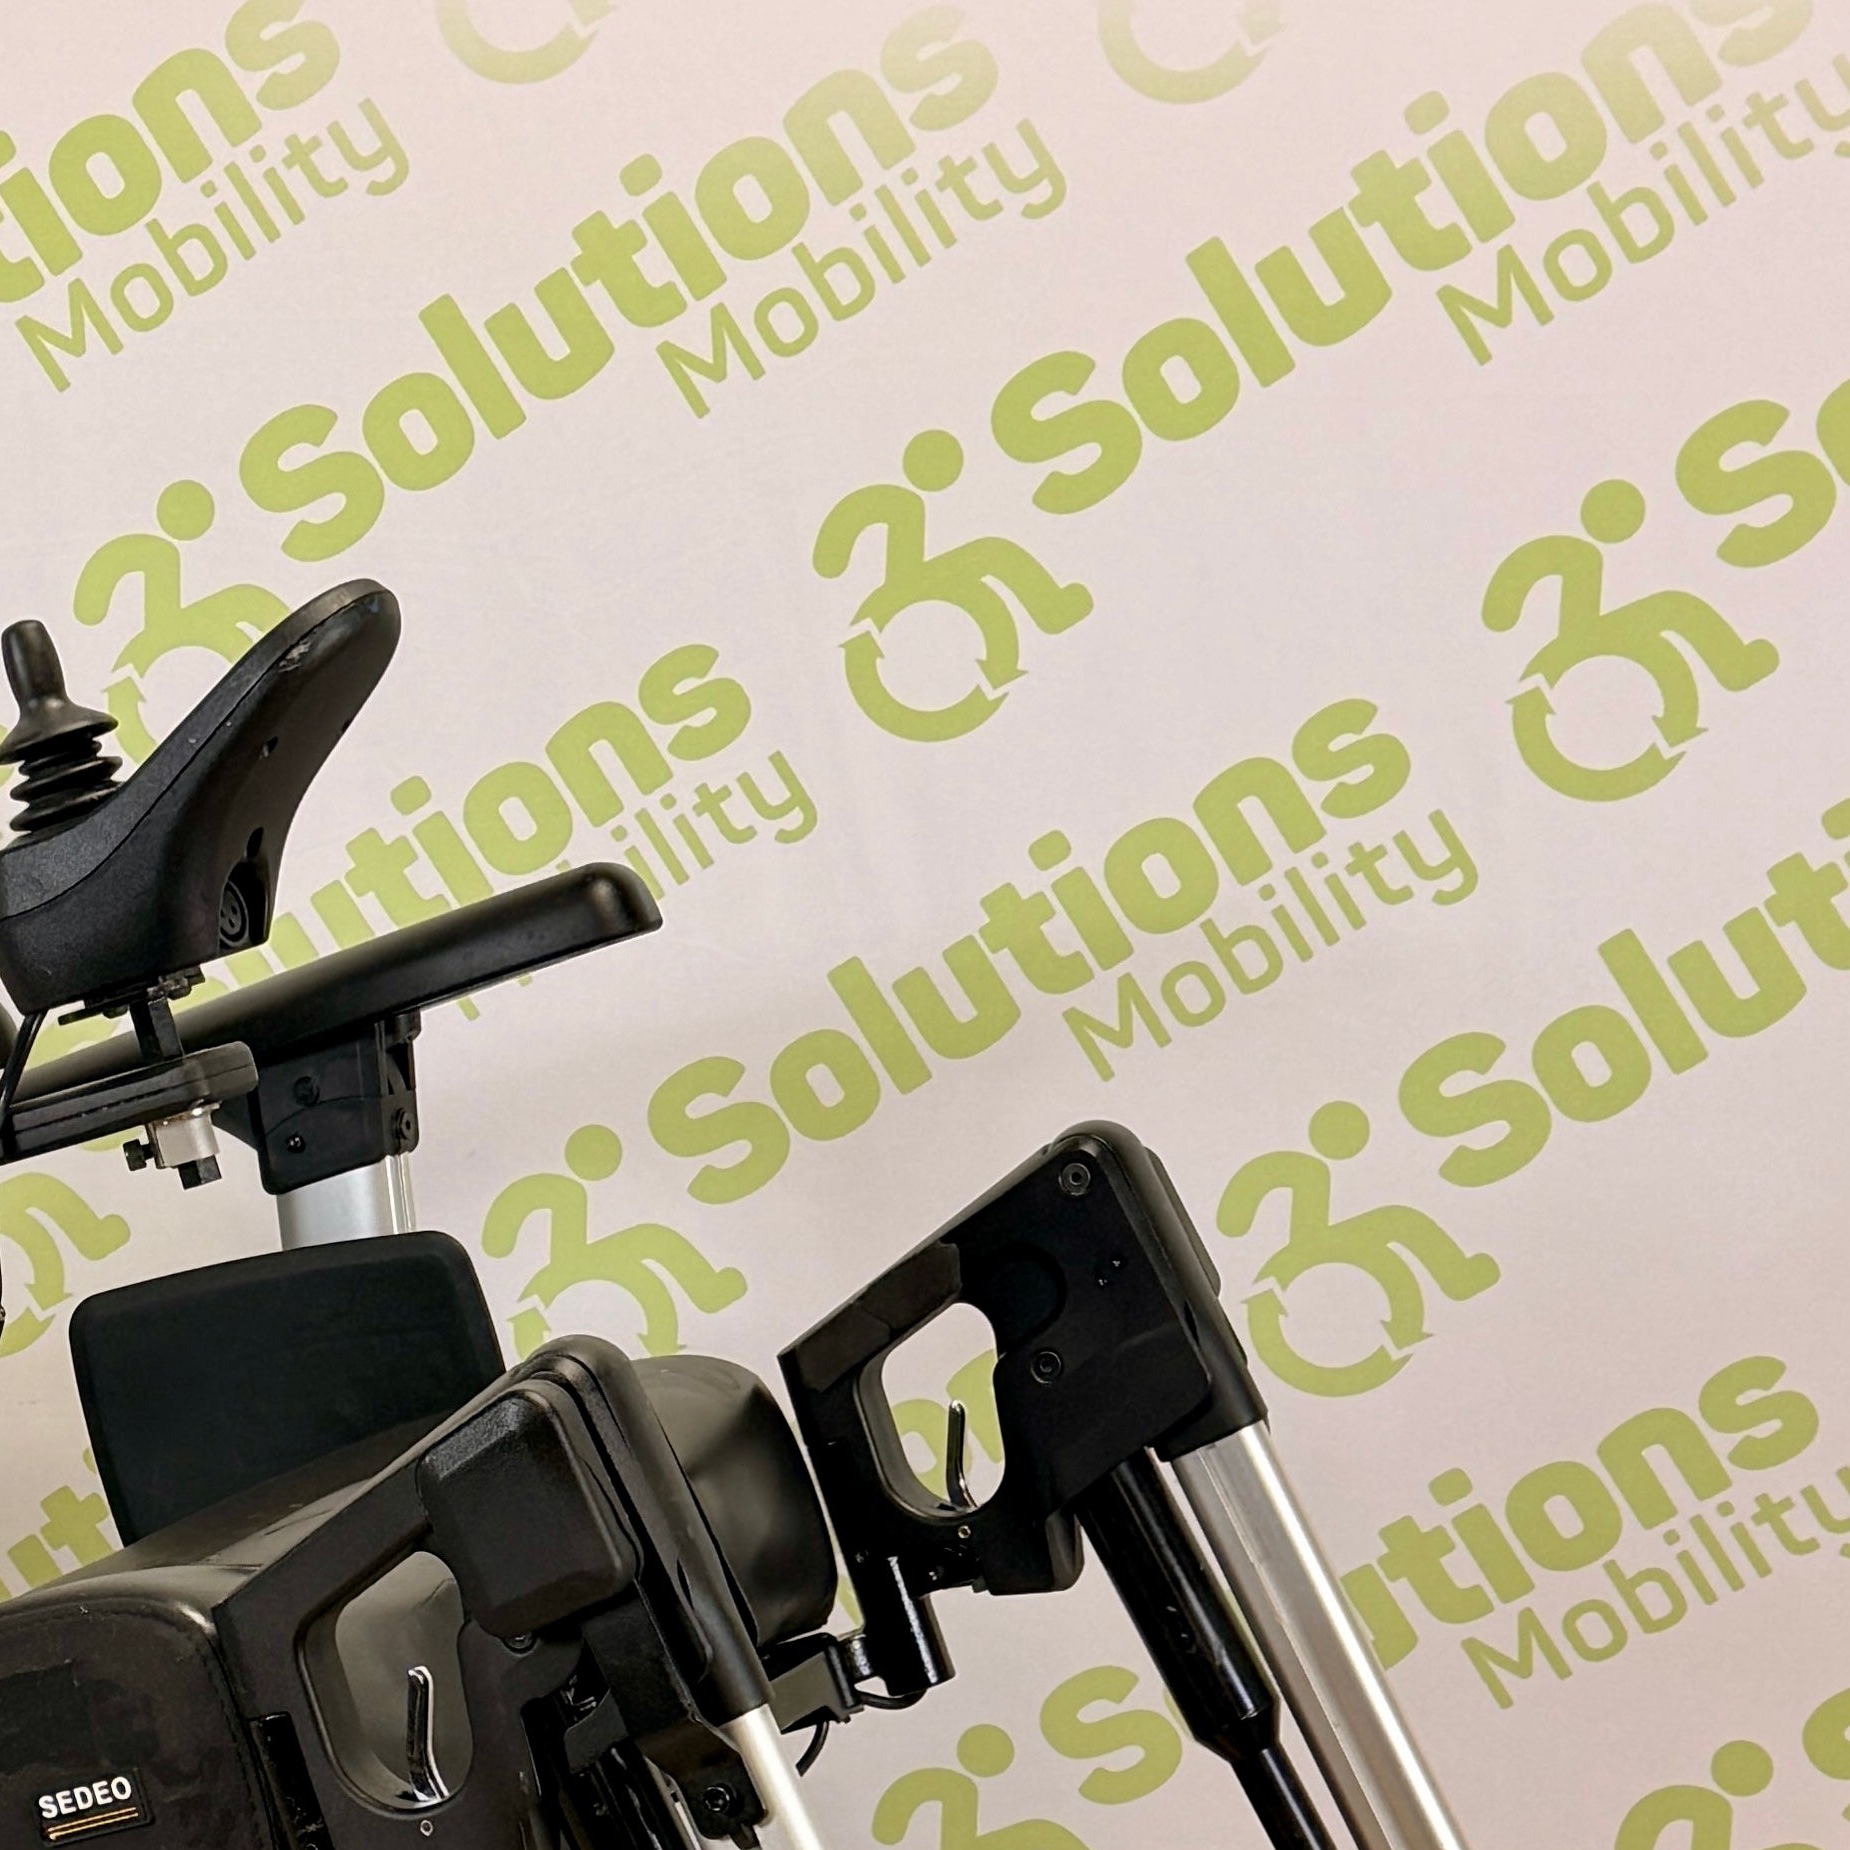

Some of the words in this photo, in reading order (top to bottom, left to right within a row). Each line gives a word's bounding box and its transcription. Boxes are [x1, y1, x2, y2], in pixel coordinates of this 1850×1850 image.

[13, 97, 410, 393] Mobility
[238, 4, 1000, 562] Solutions
[653, 117, 1068, 419] Mobility
[647, 697, 1412, 1205] Solutions
[1062, 808, 1479, 1083] Mobility
[1398, 797, 1850, 1189] Solut
[38, 1776, 132, 1819] SEDEO
